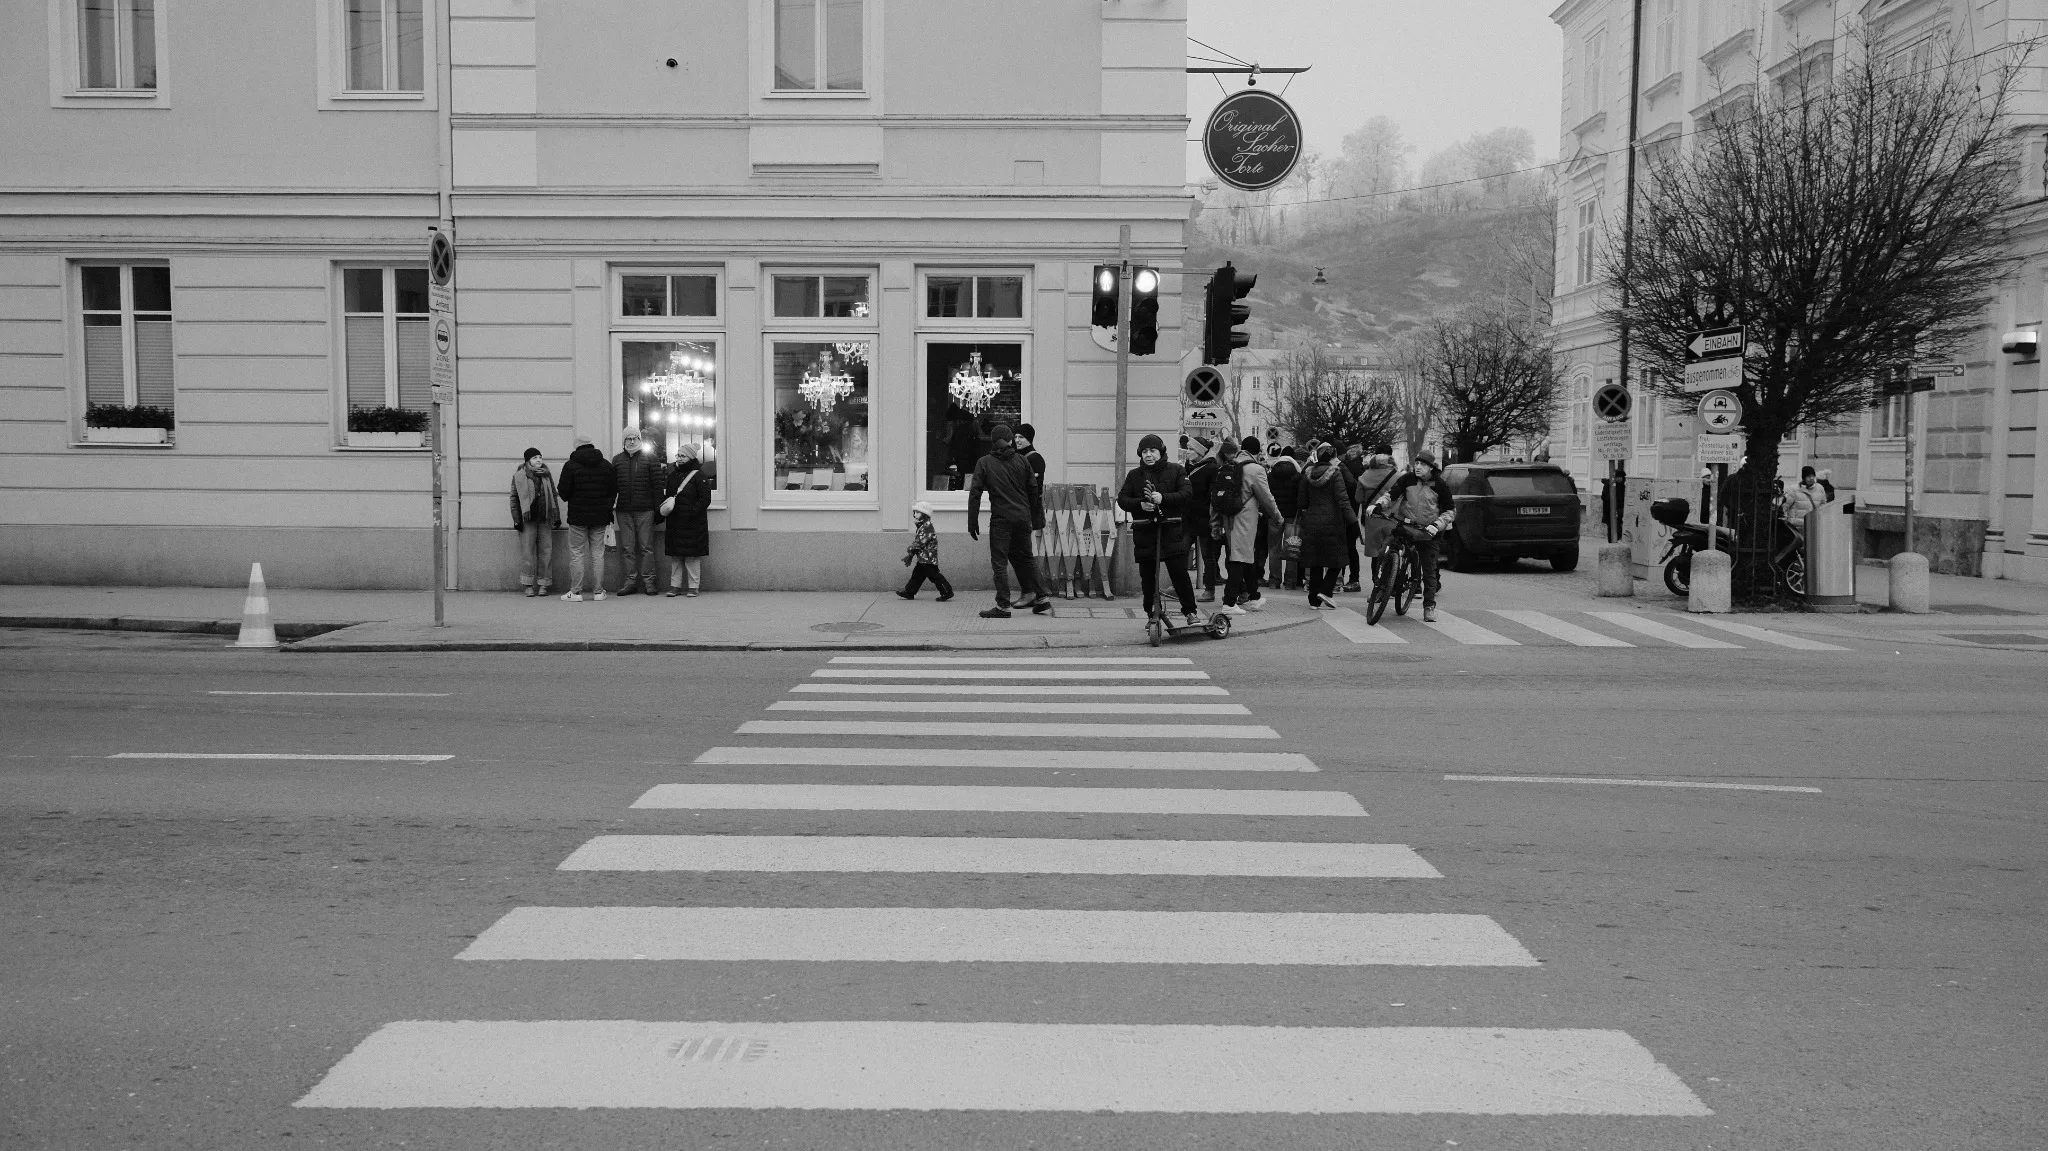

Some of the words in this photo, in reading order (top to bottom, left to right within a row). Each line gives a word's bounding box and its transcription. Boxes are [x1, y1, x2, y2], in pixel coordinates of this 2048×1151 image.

[1213, 109, 1288, 139] Original
[1236, 131, 1295, 153] Sacher
[1224, 152, 1265, 174] Torte
[1704, 334, 1739, 351] EINBAHN
[1685, 367, 1728, 386] ausgenommen
